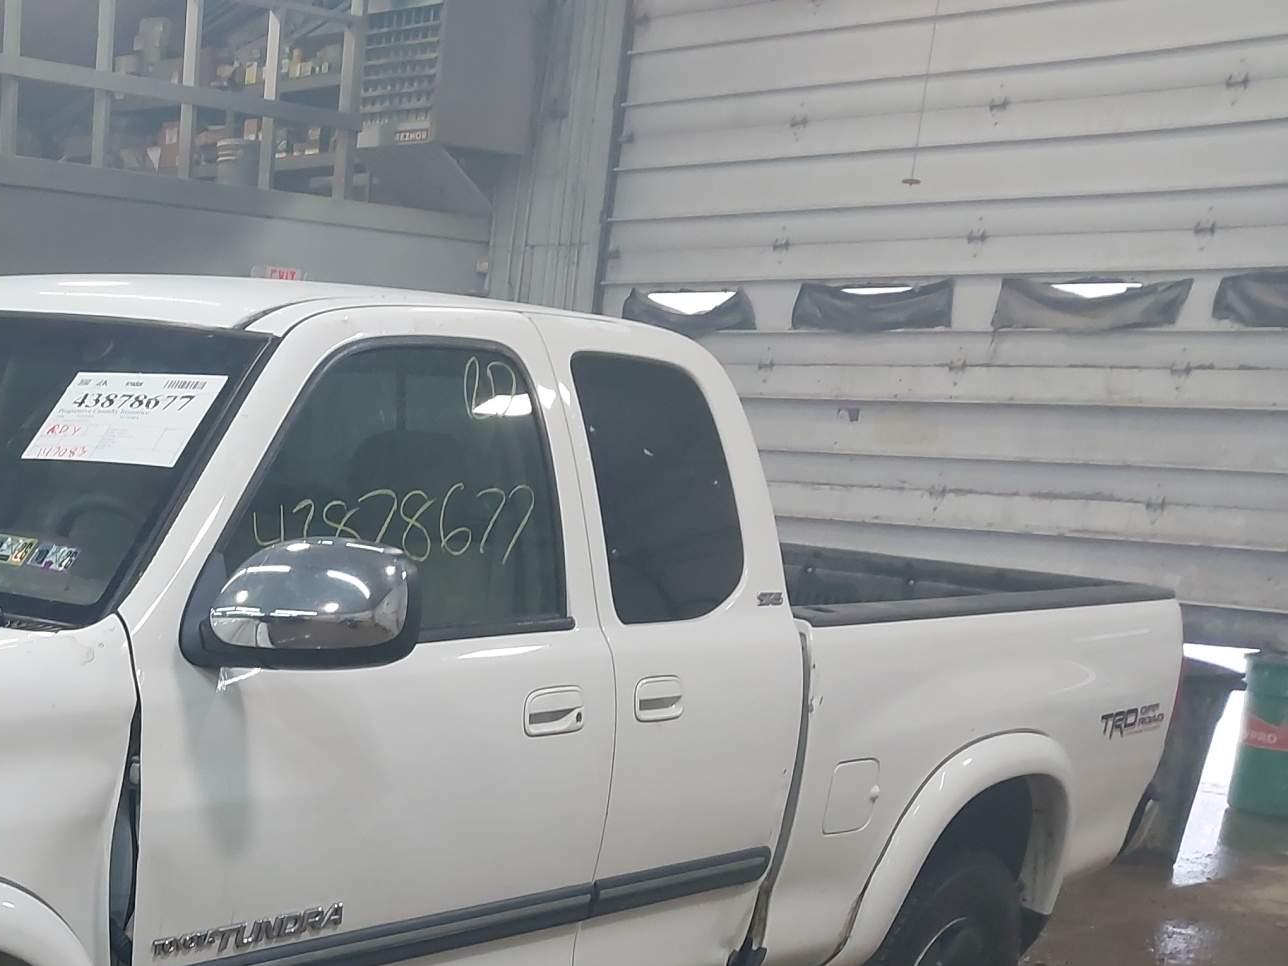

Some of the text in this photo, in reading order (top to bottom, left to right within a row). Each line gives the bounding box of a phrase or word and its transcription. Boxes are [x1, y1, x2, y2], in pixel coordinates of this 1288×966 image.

[72, 392, 196, 412] 43878677
[1101, 708, 1139, 740] TRD
[152, 901, 343, 955] TOYOTA TUNDRA
